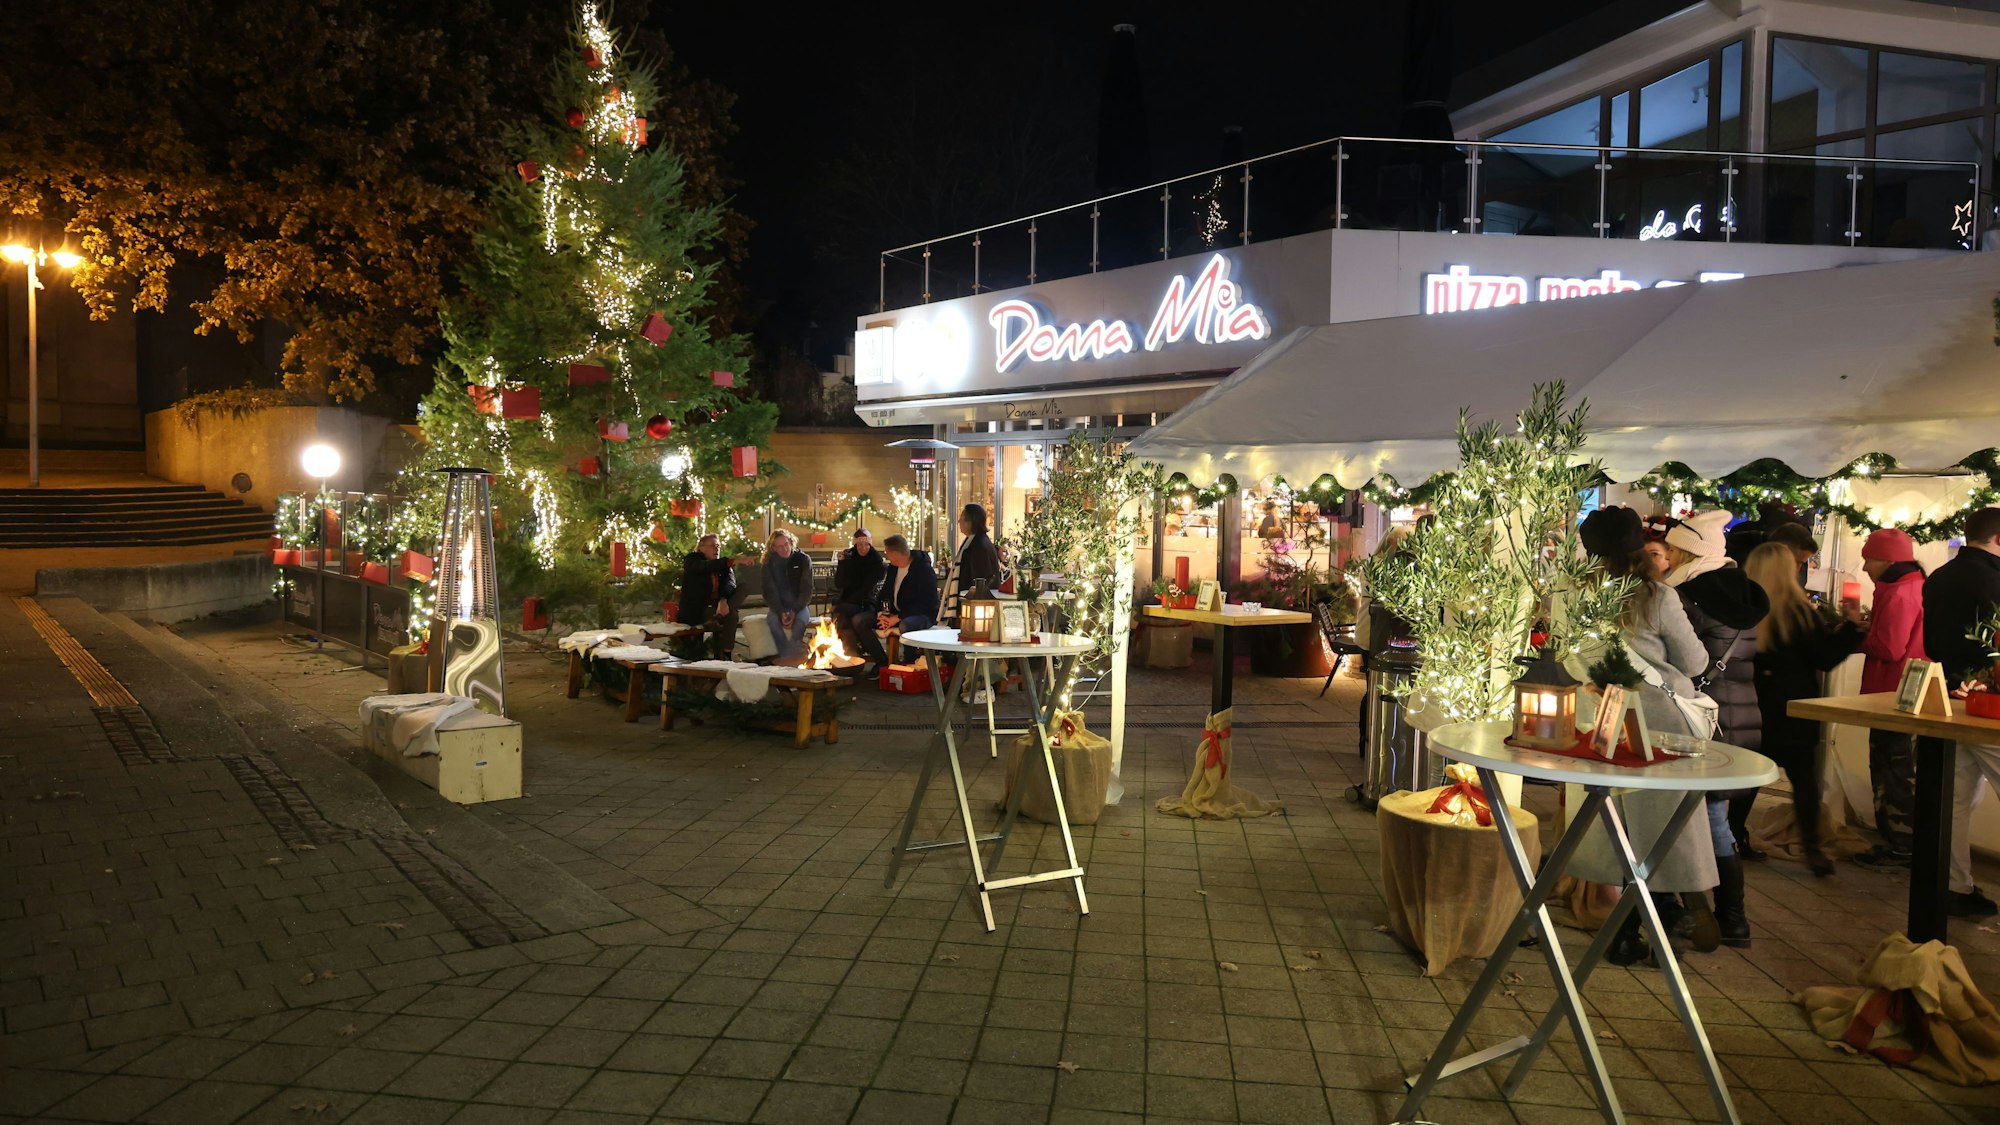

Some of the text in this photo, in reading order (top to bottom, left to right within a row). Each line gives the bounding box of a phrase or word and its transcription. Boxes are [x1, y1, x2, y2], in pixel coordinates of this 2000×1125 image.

[989, 253, 1264, 372] Donna Mia
[1004, 398, 1063, 418] Donna Mia
